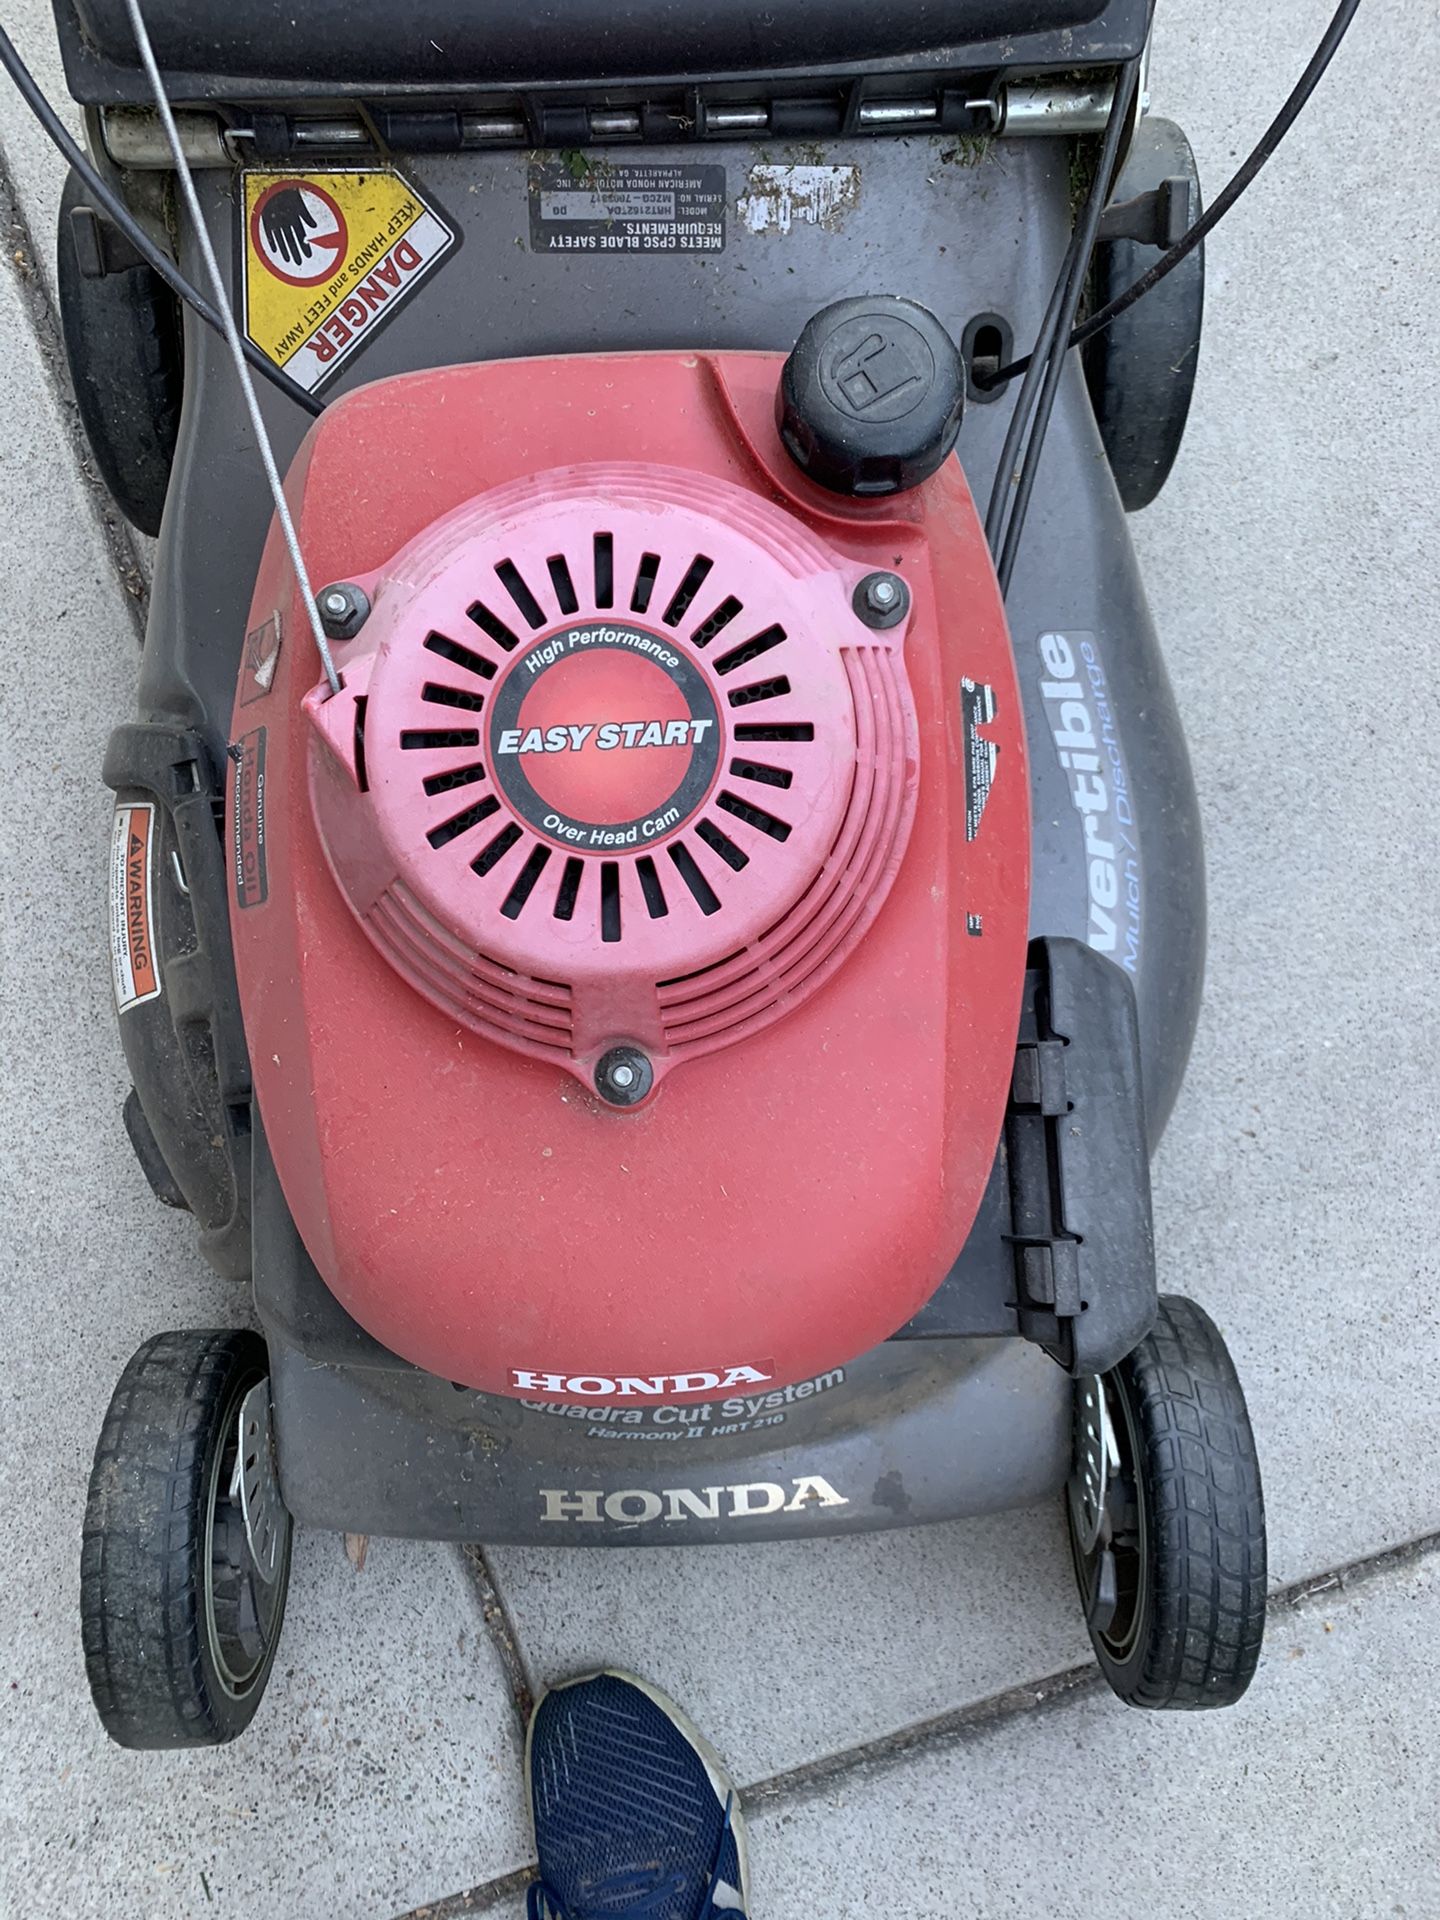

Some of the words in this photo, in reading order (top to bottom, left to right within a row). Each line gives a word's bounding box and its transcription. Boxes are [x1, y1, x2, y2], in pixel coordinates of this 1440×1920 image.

[627, 179, 656, 189] HONDA
[658, 179, 702, 189] AMERICAN
[695, 194, 722, 204] SERIAL
[388, 200, 417, 236] KEEP
[622, 222, 721, 236] REQUIREMENTS.
[677, 206, 708, 216] MODEL:
[348, 232, 388, 276] HANDS
[549, 235, 597, 249] SAFETY
[601, 236, 640, 248] BLADE
[643, 236, 676, 248] CPSC
[681, 236, 722, 249] MEETS
[306, 238, 423, 363] DANGER
[328, 275, 349, 298] and
[303, 294, 332, 327] FEET
[274, 322, 305, 359] AWAY
[525, 639, 564, 675] High
[568, 627, 680, 669] Performance
[497, 723, 594, 755] EASY
[595, 719, 713, 750] START
[1079, 641, 1134, 826] Discharge
[242, 747, 256, 841] Honda
[257, 773, 265, 845] Genuine
[235, 762, 244, 886] Recommended
[543, 813, 586, 843] Over
[589, 826, 638, 846] Head
[641, 805, 681, 836] Cam
[119, 853, 126, 866] TO
[244, 851, 257, 892] Oil
[129, 859, 148, 970] WARNING
[1123, 860, 1140, 973] Mulch
[512, 1365, 772, 1396] HONDA
[652, 1404, 712, 1425] Cut
[722, 1367, 845, 1420] System
[587, 1426, 684, 1442] Harmony
[687, 1425, 705, 1439] II
[711, 1422, 750, 1437] HRT
[753, 1414, 785, 1430] 216
[539, 1474, 850, 1523] HONDA
